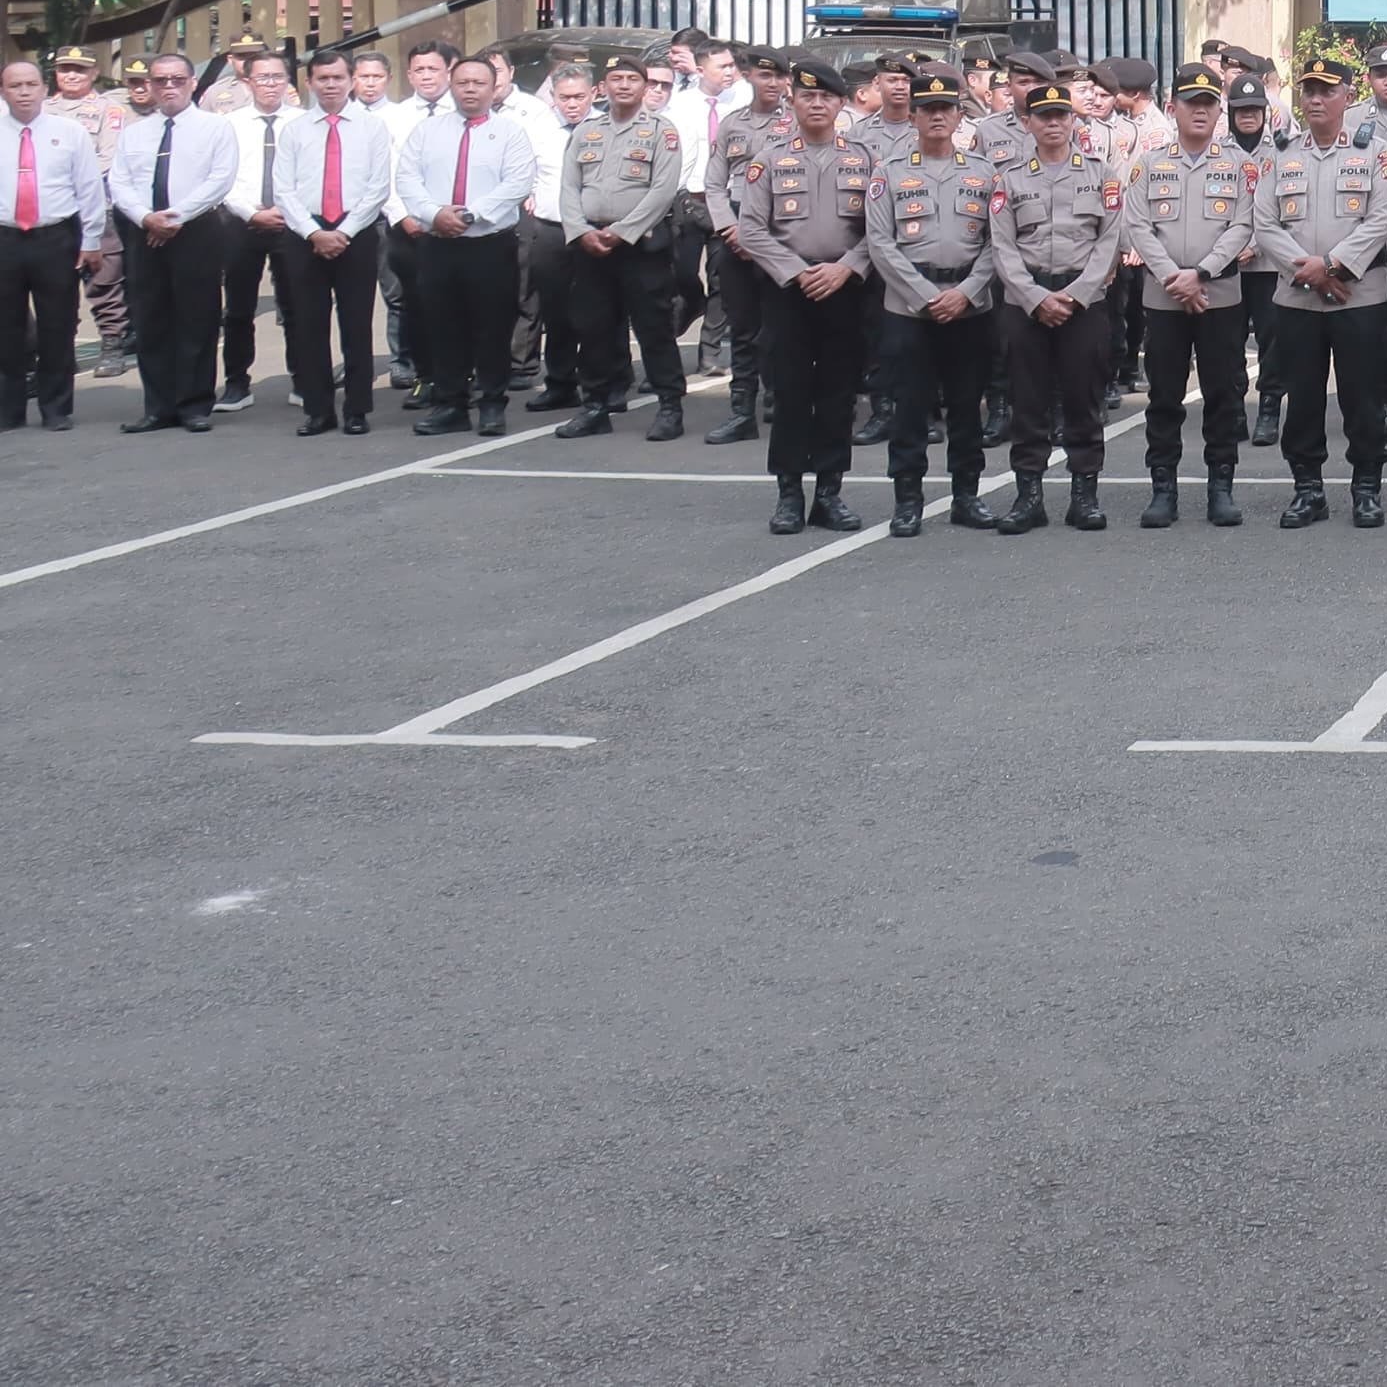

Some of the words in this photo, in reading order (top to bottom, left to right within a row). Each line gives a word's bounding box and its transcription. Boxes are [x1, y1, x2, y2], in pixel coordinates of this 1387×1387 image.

[838, 167, 869, 176] POLRI
[1281, 171, 1305, 179] ANDRY
[1340, 167, 1369, 176] POLRI
[1150, 173, 1179, 182] DANIEL
[1206, 173, 1237, 182] POLRI
[896, 189, 928, 202] ZUHRI
